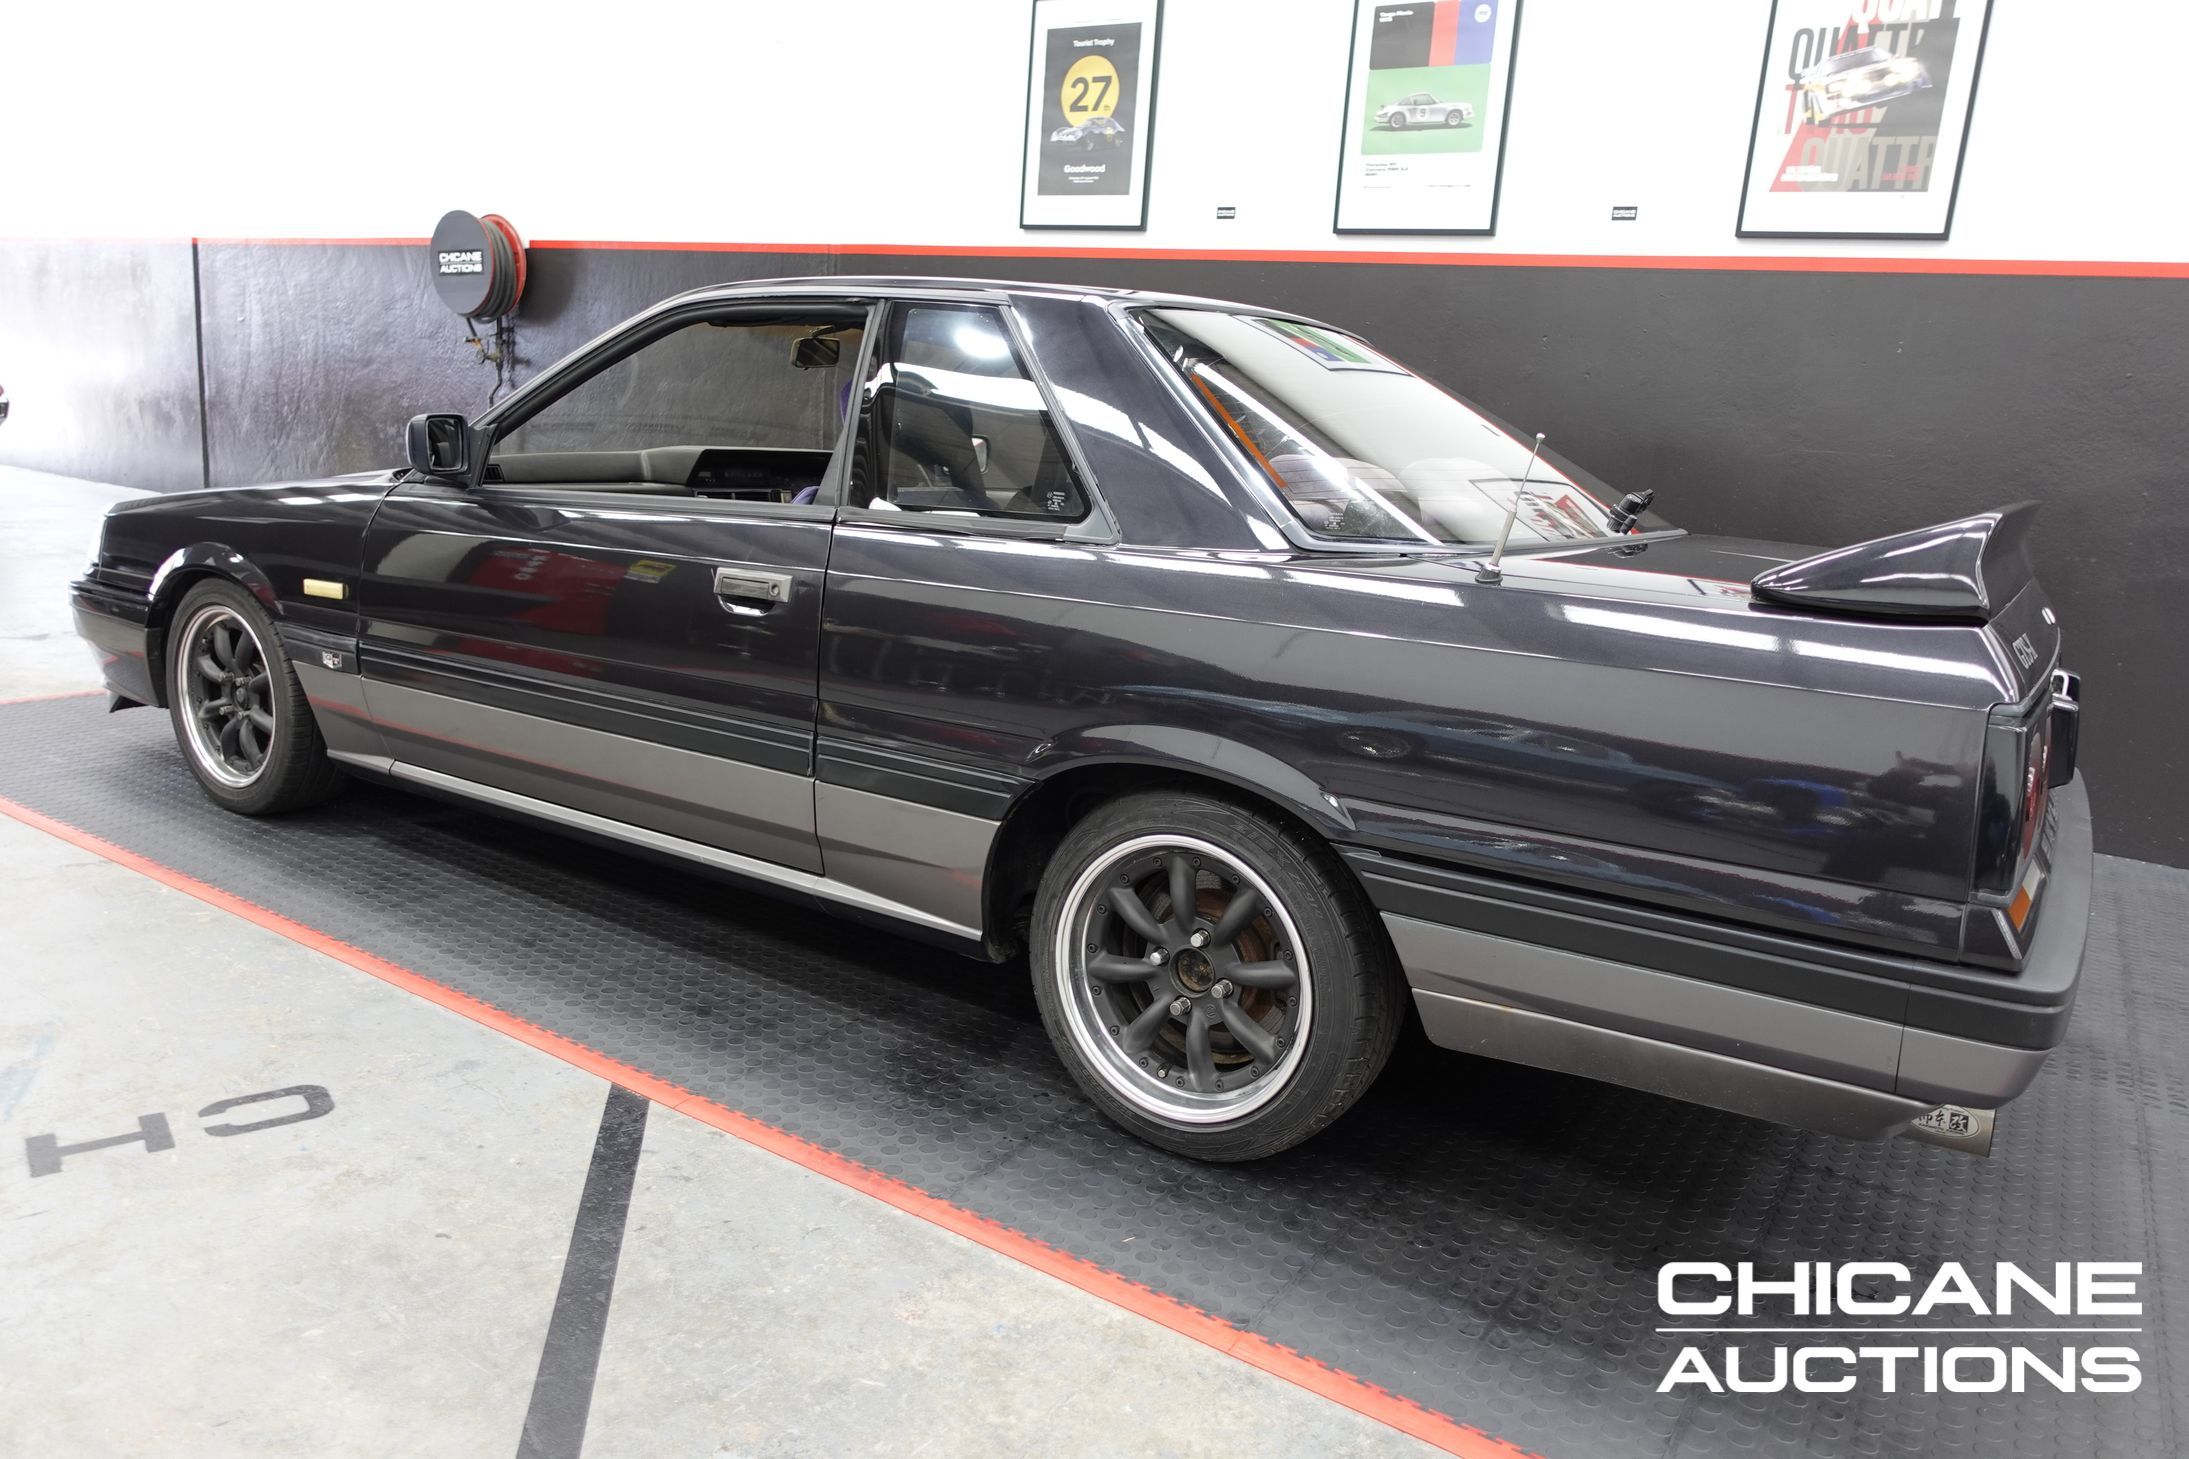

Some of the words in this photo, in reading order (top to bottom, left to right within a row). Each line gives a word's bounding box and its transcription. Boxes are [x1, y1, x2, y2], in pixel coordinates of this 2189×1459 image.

[1069, 75, 1112, 112] 27
[1063, 164, 1106, 173] Goodwood
[439, 251, 482, 262] CHICANE
[440, 264, 483, 273] AUCTIONS
